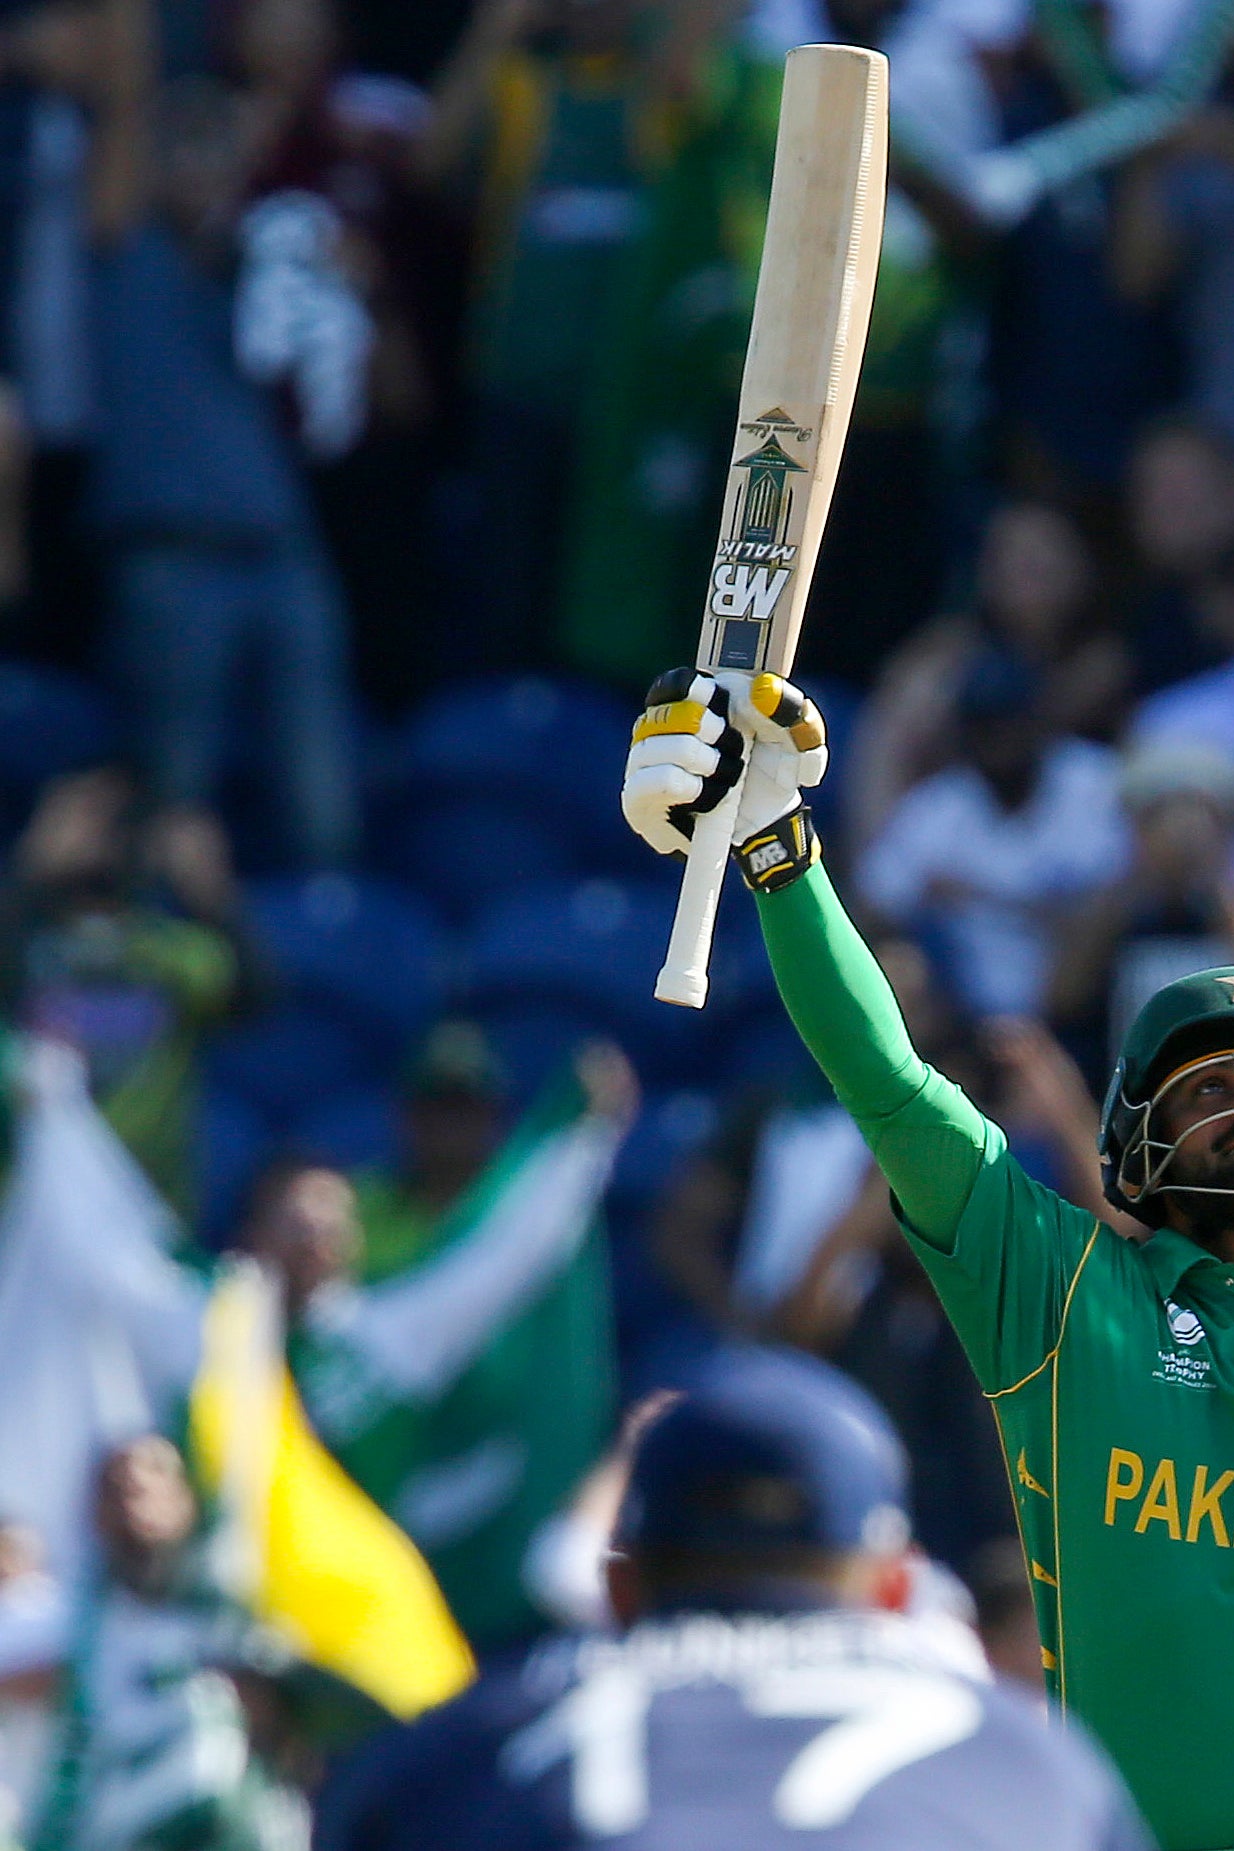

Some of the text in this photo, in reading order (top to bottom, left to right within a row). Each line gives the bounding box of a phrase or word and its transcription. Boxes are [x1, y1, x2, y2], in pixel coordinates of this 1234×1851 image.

[718, 540, 797, 561] MALIK
[710, 564, 790, 619] MB
[749, 840, 788, 874] MB
[1164, 1363, 1205, 1379] TROPHY
[502, 1662, 984, 1838] 17
